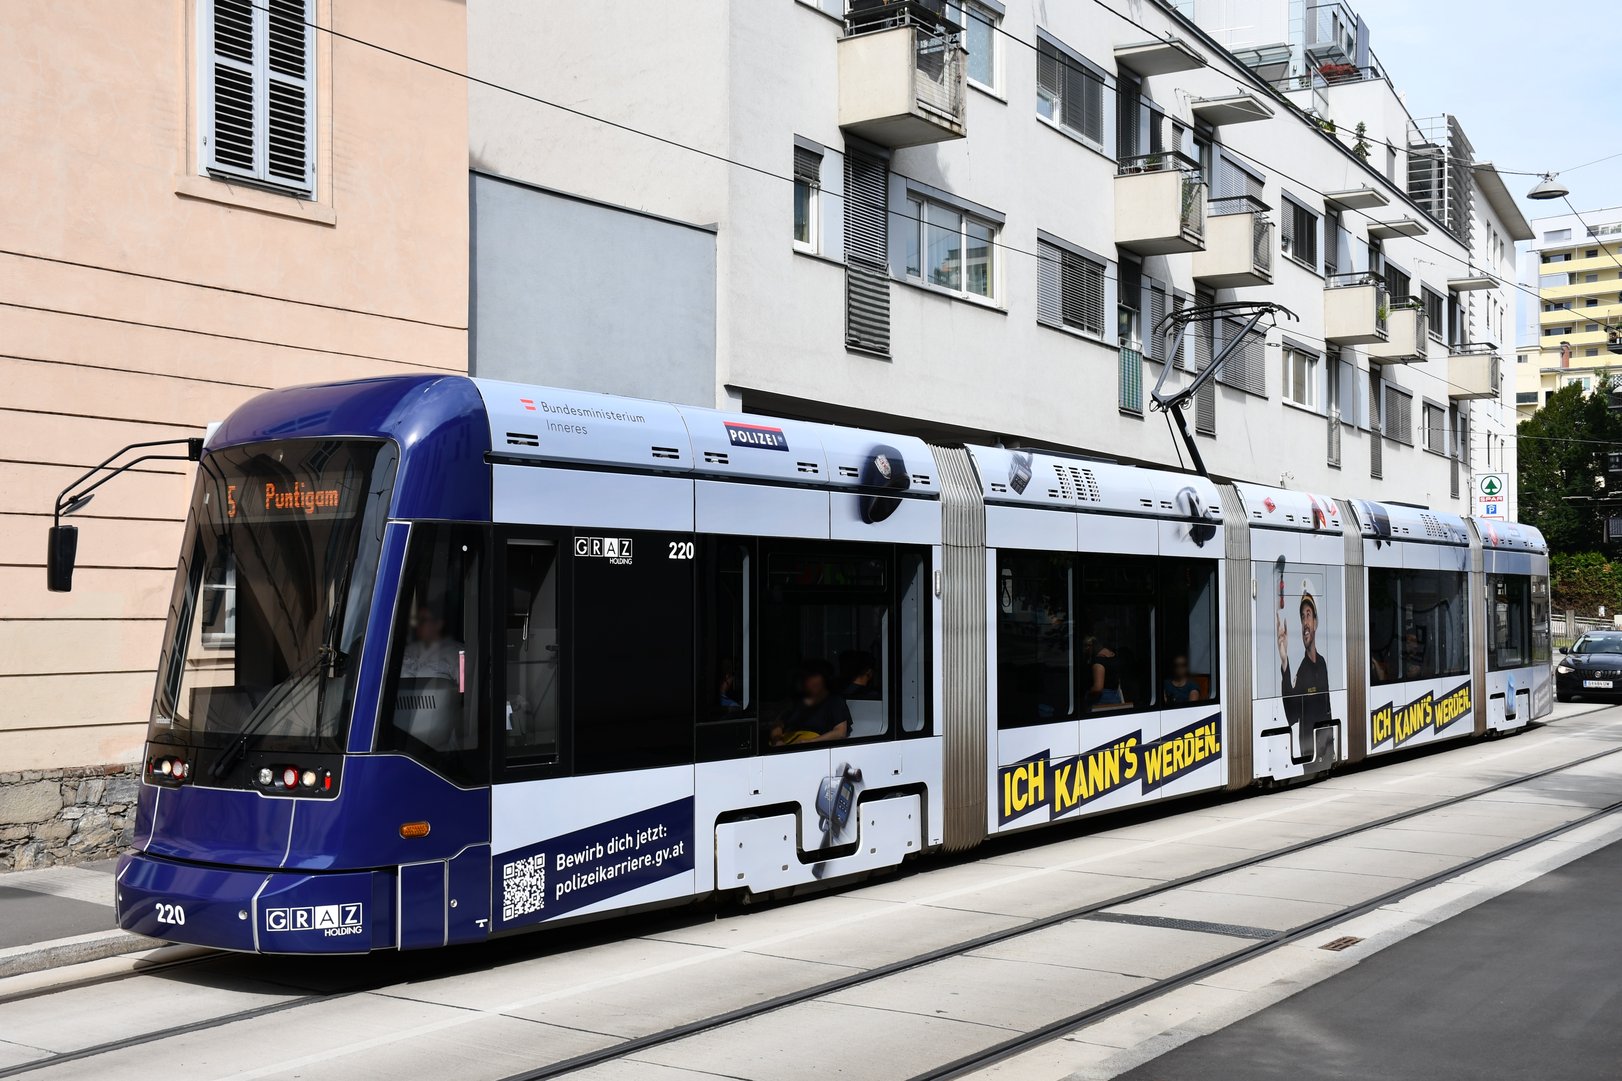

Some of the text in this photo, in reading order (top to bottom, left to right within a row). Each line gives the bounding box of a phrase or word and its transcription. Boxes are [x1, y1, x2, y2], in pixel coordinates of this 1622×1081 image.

[541, 401, 646, 424] Bundesministerium
[546, 419, 588, 435] Inneres
[729, 429, 778, 446] POLIZEI
[227, 481, 339, 518] 5 Puntigam
[575, 537, 632, 557] GRAZ
[668, 542, 694, 559] 220
[1373, 686, 1471, 744] ICH KANN'S WERDEN.
[1004, 721, 1220, 817] ICH KANN'S WERDEN.
[556, 824, 668, 871] Bewirb dich jetzt:
[555, 841, 684, 900] polizeikarriere.gv.at
[155, 903, 185, 925] 220
[266, 903, 363, 932] GRAZ
[324, 926, 363, 937] HOLDING
